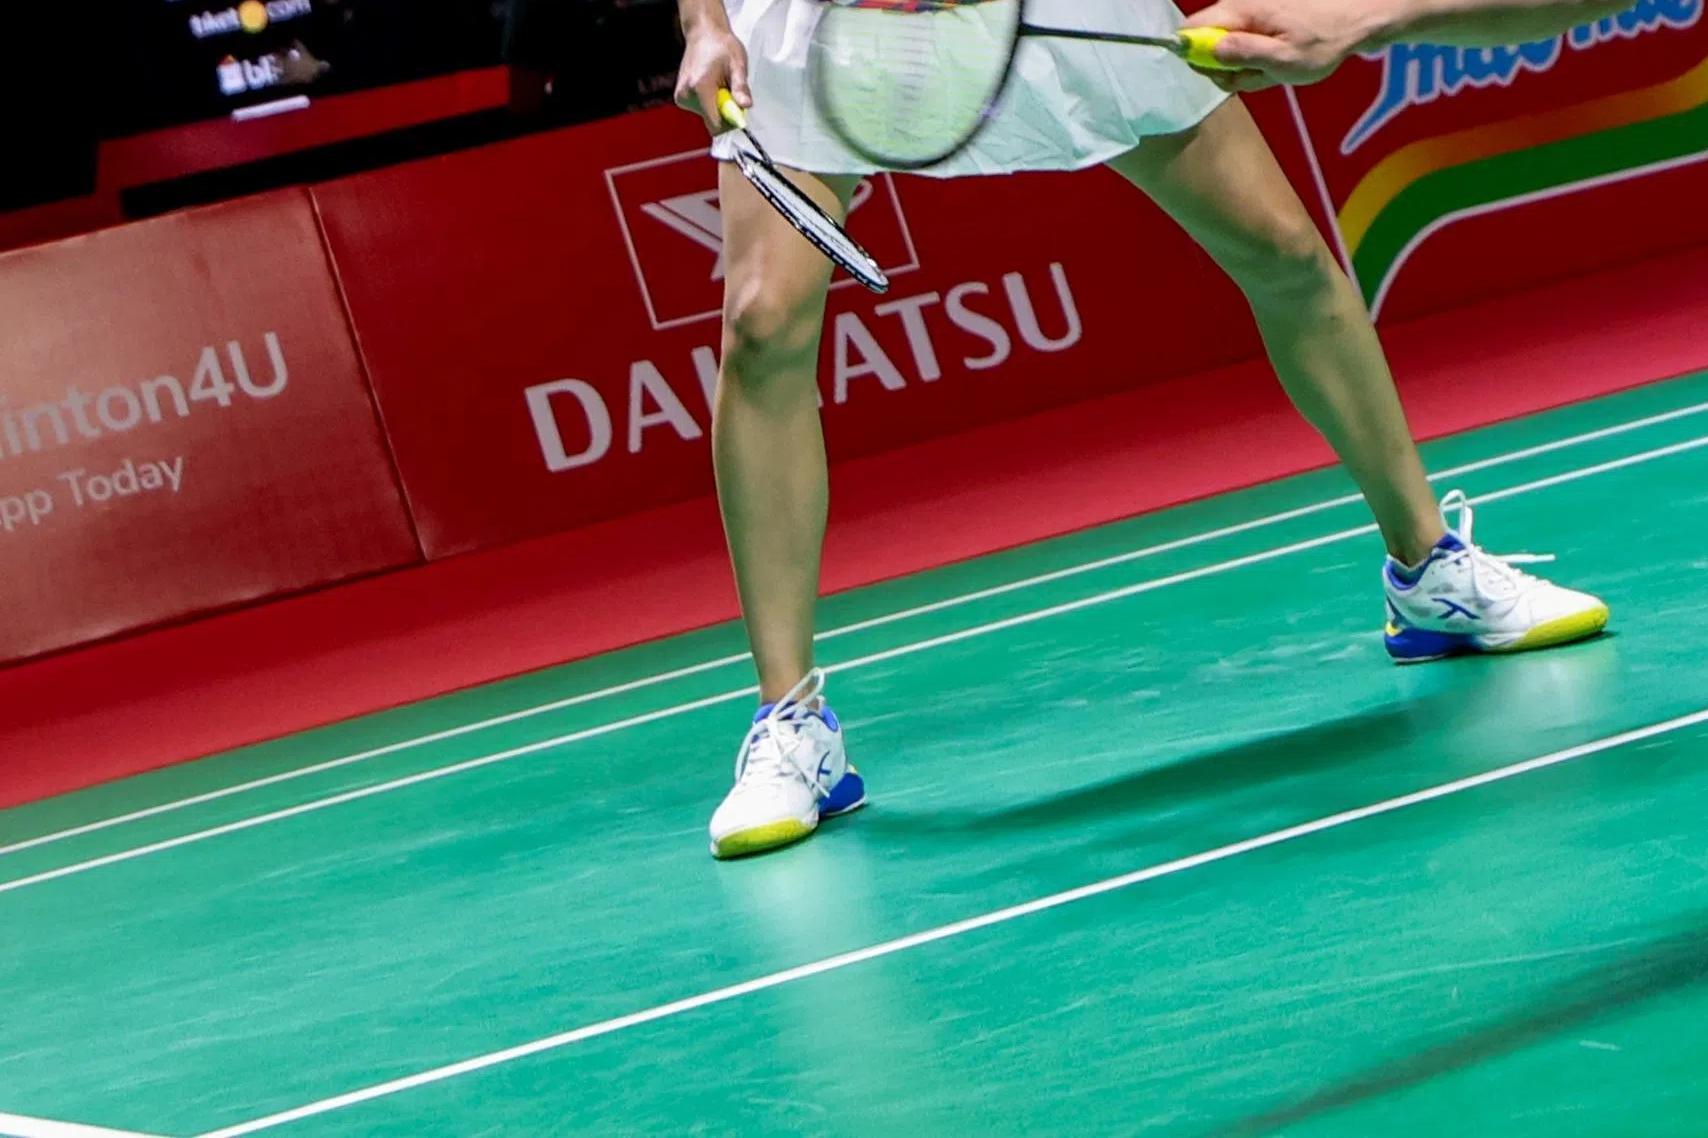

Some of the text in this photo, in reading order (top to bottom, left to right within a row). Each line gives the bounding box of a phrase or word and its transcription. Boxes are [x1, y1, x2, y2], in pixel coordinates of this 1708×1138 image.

[0, 331, 288, 459] inton4U
[525, 262, 1083, 472] DAIATSU
[0, 455, 183, 532] pp Today
